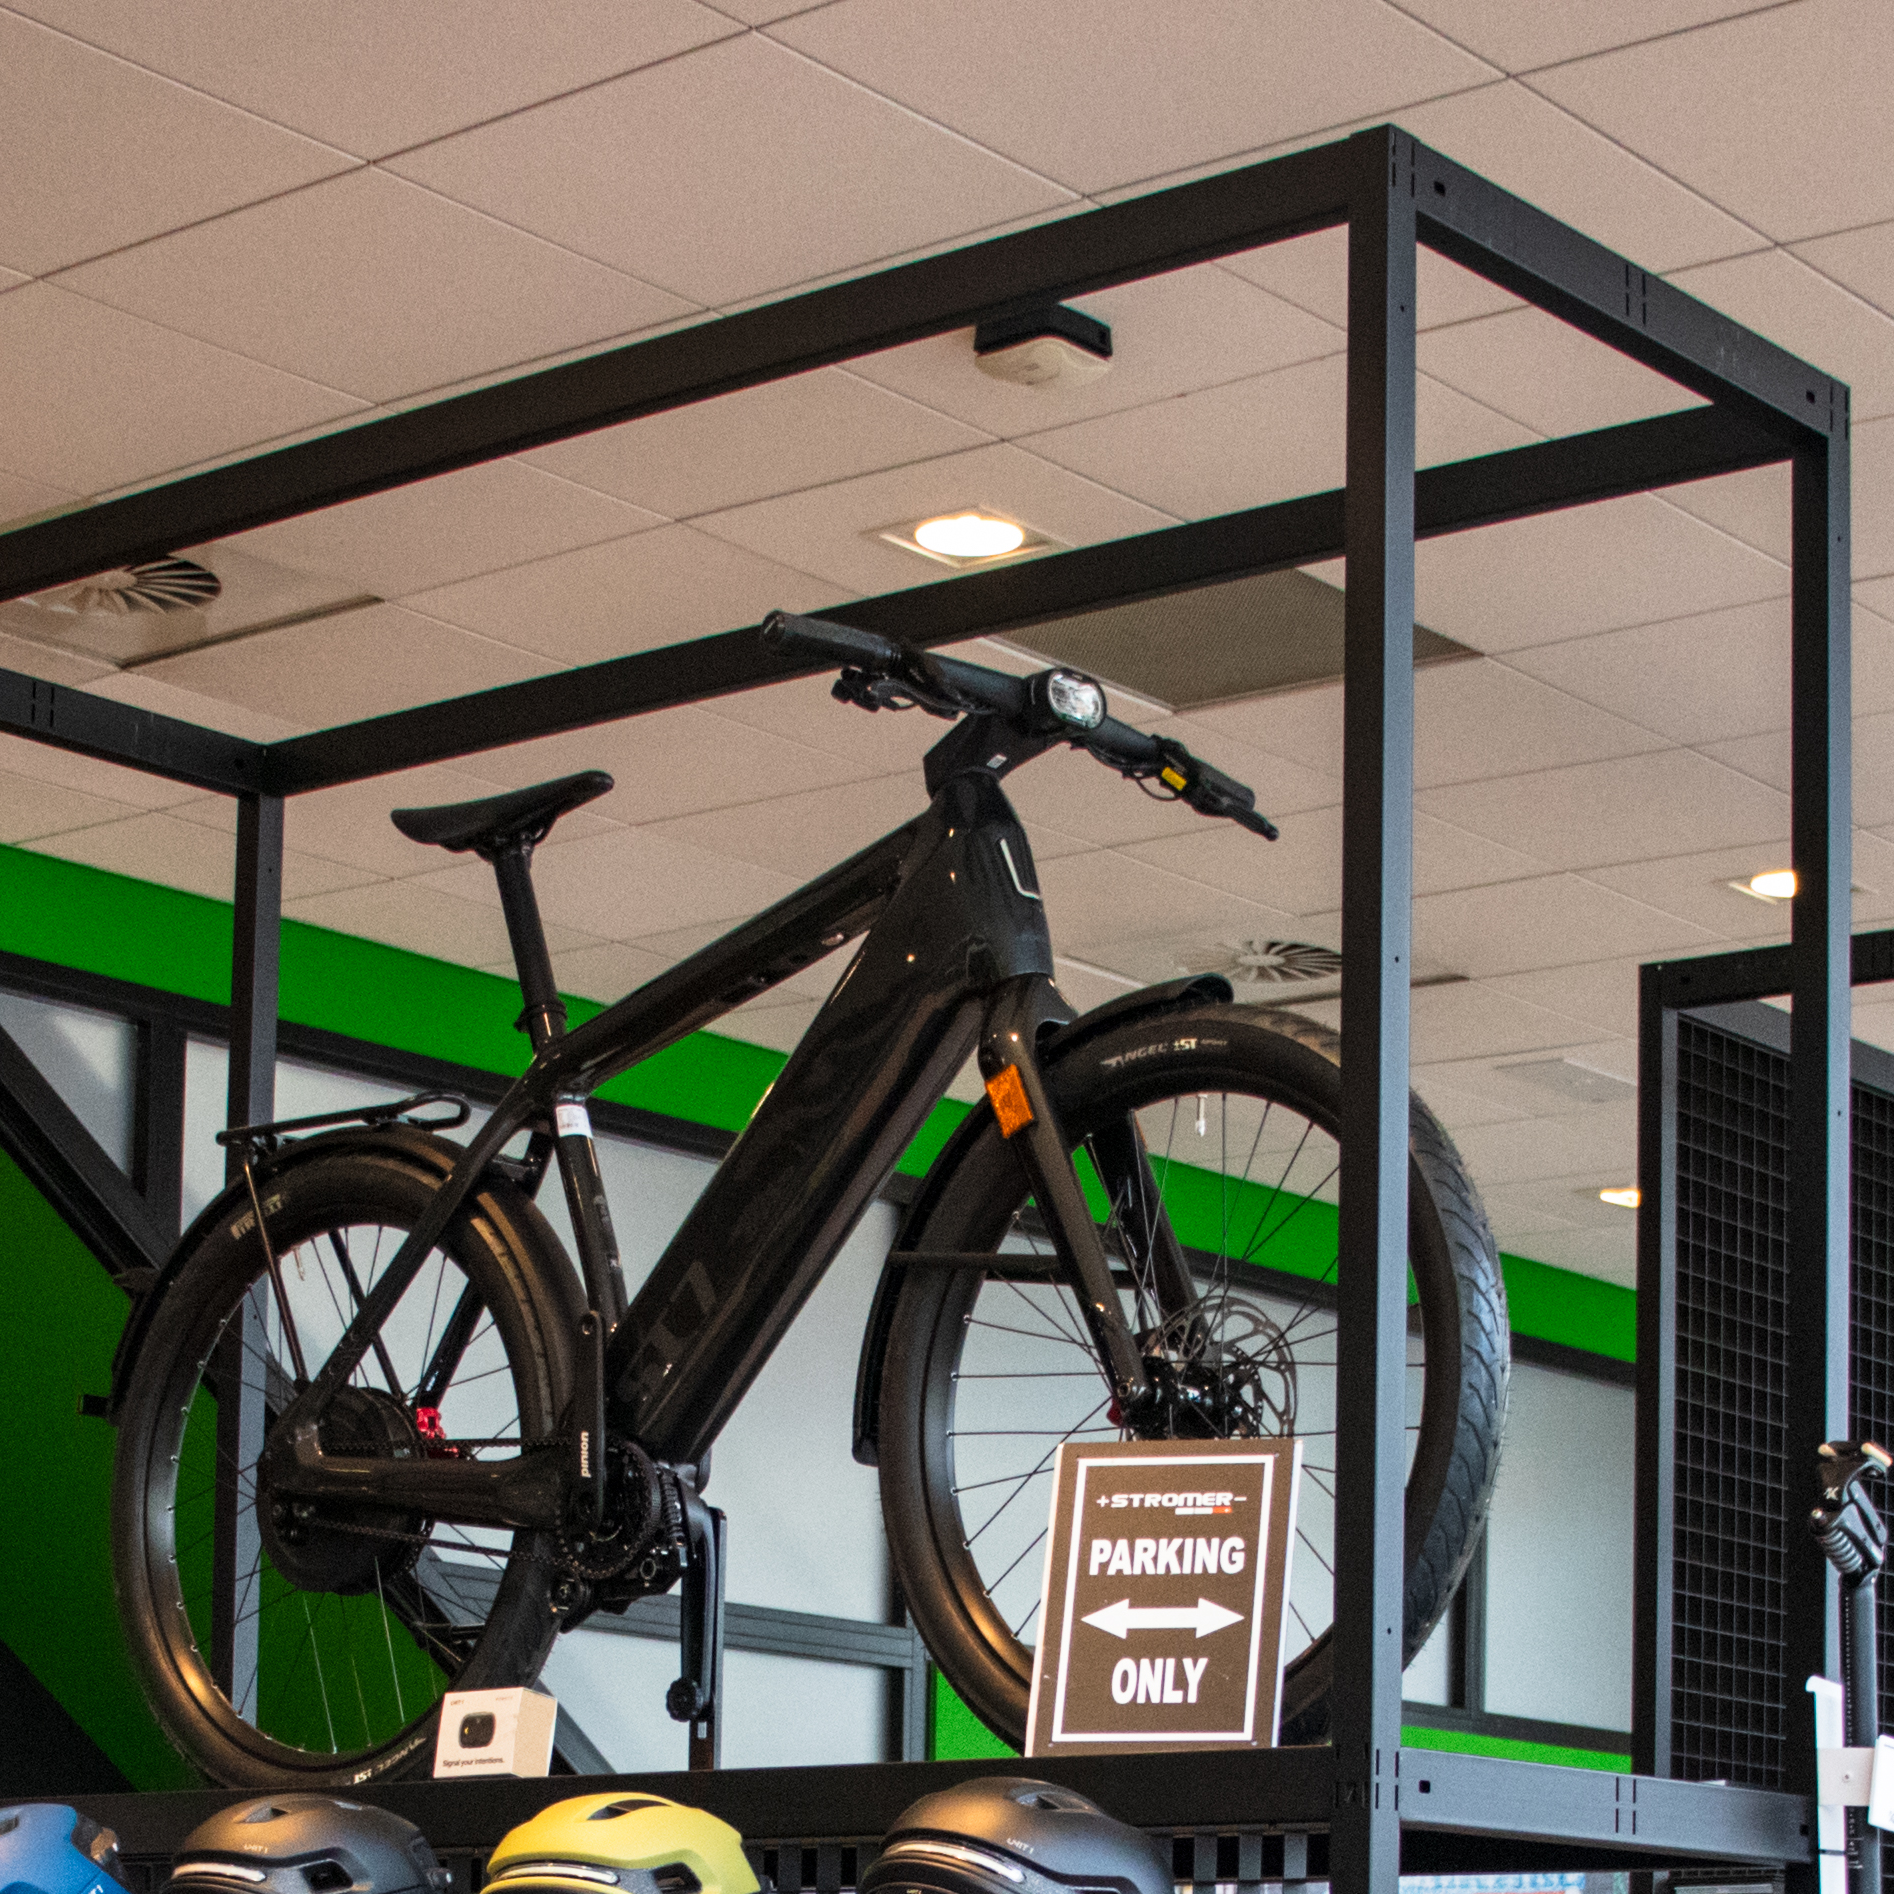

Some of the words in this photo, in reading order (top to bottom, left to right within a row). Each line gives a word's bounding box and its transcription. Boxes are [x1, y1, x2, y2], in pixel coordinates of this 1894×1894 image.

[581, 1431, 591, 1478] pinion
[1089, 1536, 1246, 1576] PARKING
[1110, 1657, 1208, 1704] ONLY
[442, 1759, 460, 1768] Signal
